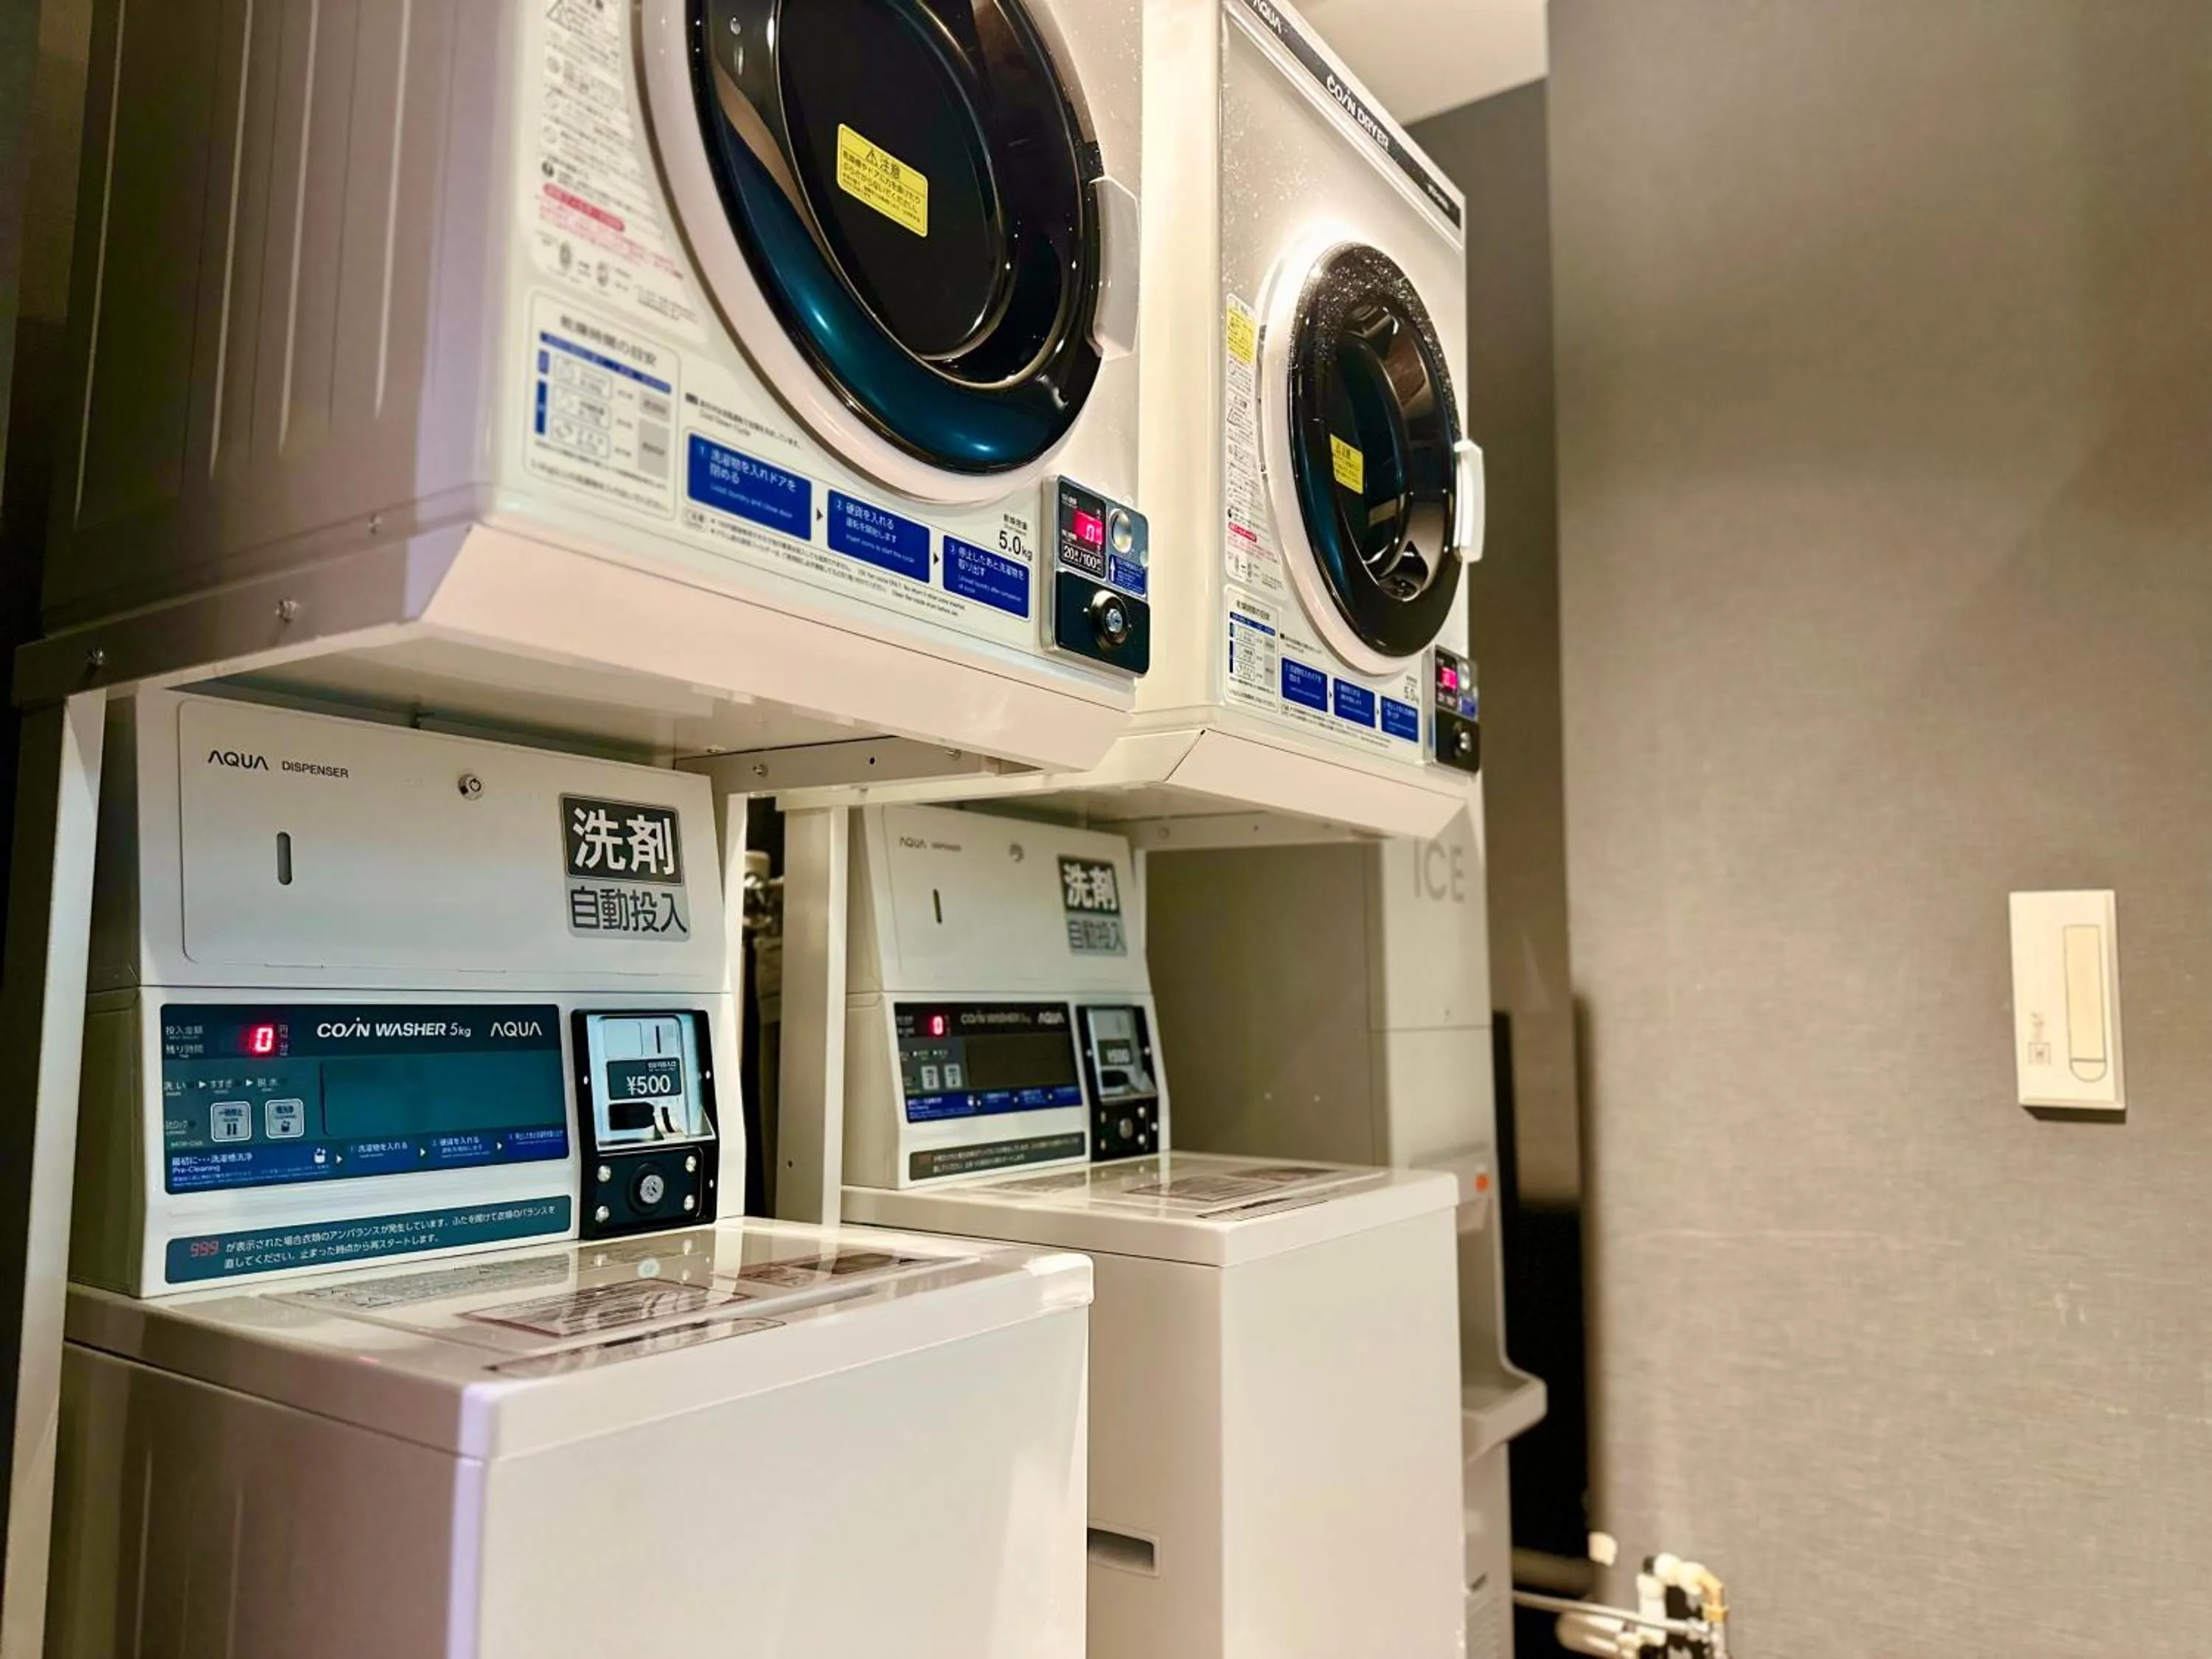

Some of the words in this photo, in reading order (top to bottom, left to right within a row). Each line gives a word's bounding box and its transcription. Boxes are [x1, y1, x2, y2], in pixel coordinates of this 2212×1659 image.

[208, 750, 269, 771] AQUA
[282, 760, 349, 779] DISPENSER
[573, 807, 675, 875] 洗剤
[1413, 837, 1464, 902] ICE
[1063, 863, 1117, 910] 洗剤
[571, 886, 687, 933] 自動投入
[375, 1022, 446, 1037] WASHER
[449, 1023, 471, 1038] 5kg
[490, 1020, 543, 1037] AQUA
[931, 1015, 944, 1035] 0
[254, 1027, 274, 1052] 0
[627, 1074, 671, 1096] ¥500
[190, 1241, 219, 1257] 999
